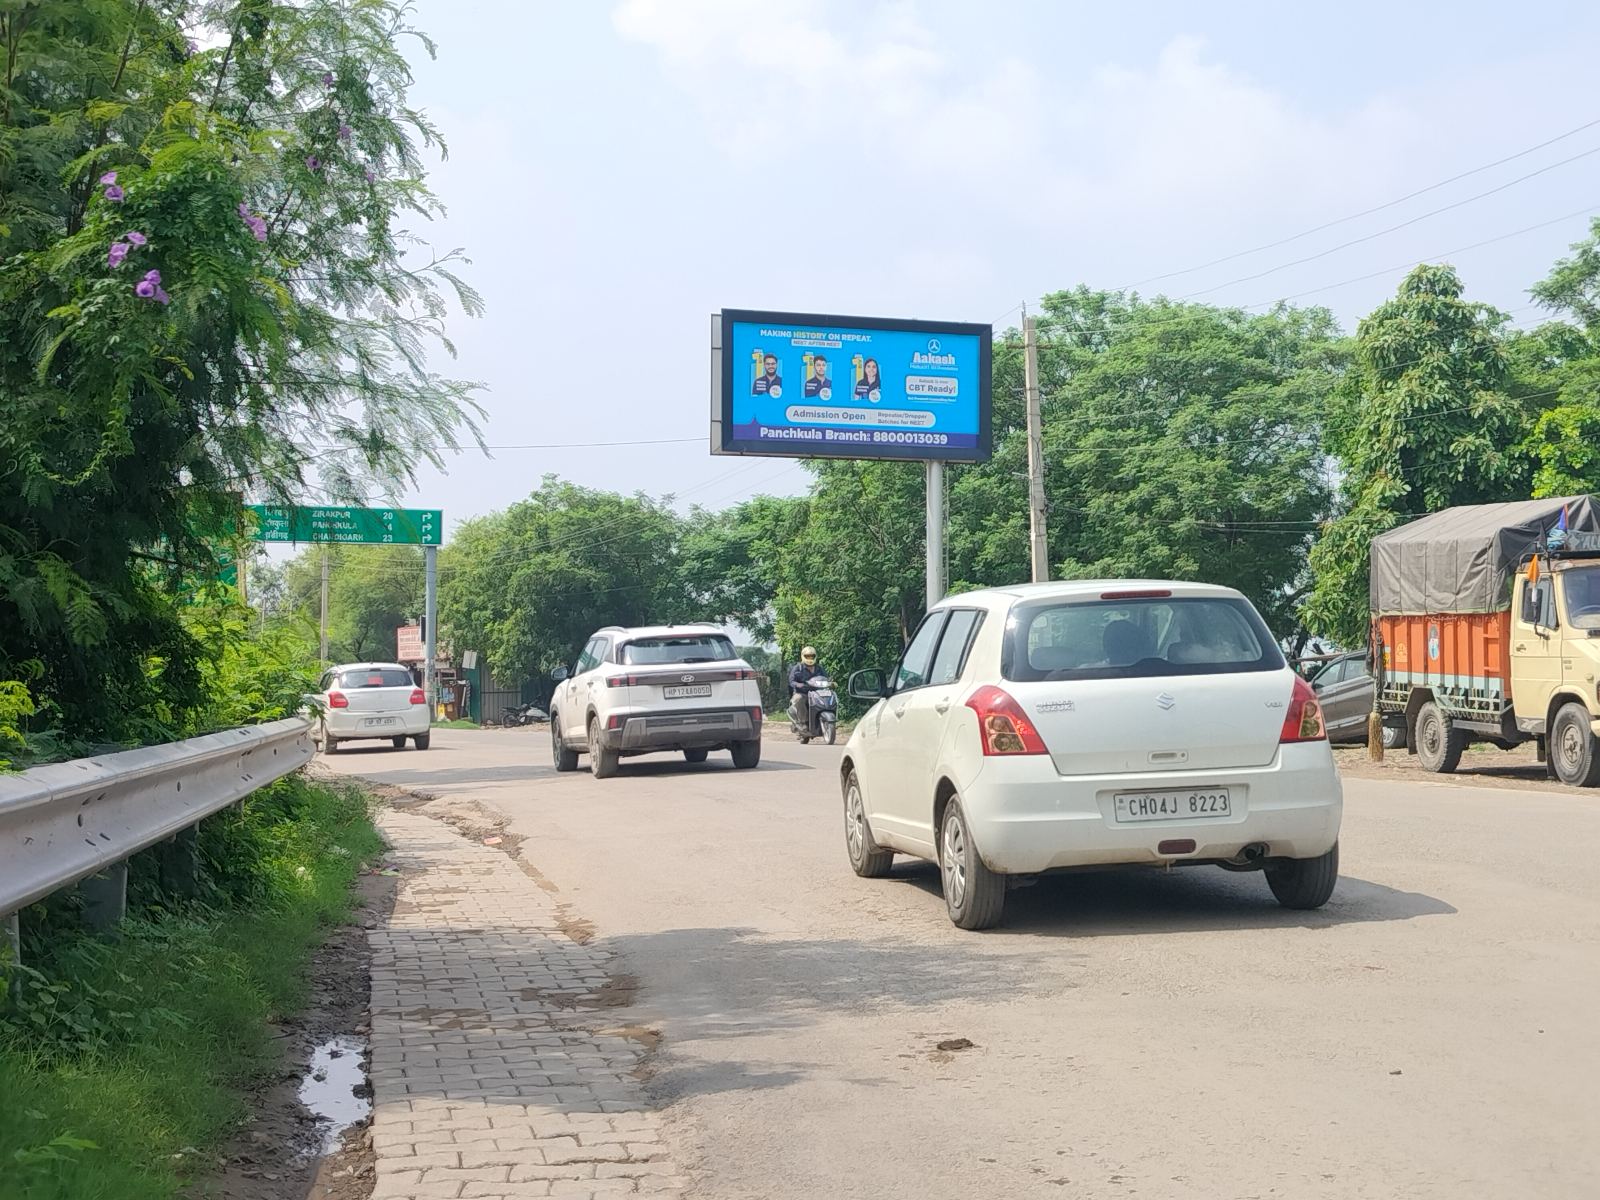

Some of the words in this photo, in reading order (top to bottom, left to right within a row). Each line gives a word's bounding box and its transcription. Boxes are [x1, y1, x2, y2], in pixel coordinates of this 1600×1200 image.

[760, 329, 792, 338] MAKING
[793, 331, 826, 340] HISTORY
[828, 332, 840, 340] ON
[842, 333, 872, 342] REPEAT.
[913, 352, 956, 365] Aakash
[927, 385, 956, 394] Ready!
[792, 409, 839, 419] Admission
[841, 411, 866, 421] Open
[759, 427, 823, 440] Panchkula
[825, 429, 871, 442] Branch:
[873, 431, 948, 444] 8800013039
[312, 510, 351, 519] ZIRAKPUR
[382, 512, 394, 520] 20
[382, 534, 393, 542] 23
[1129, 796, 1178, 816] CH04J
[1189, 795, 1228, 813] 8223
